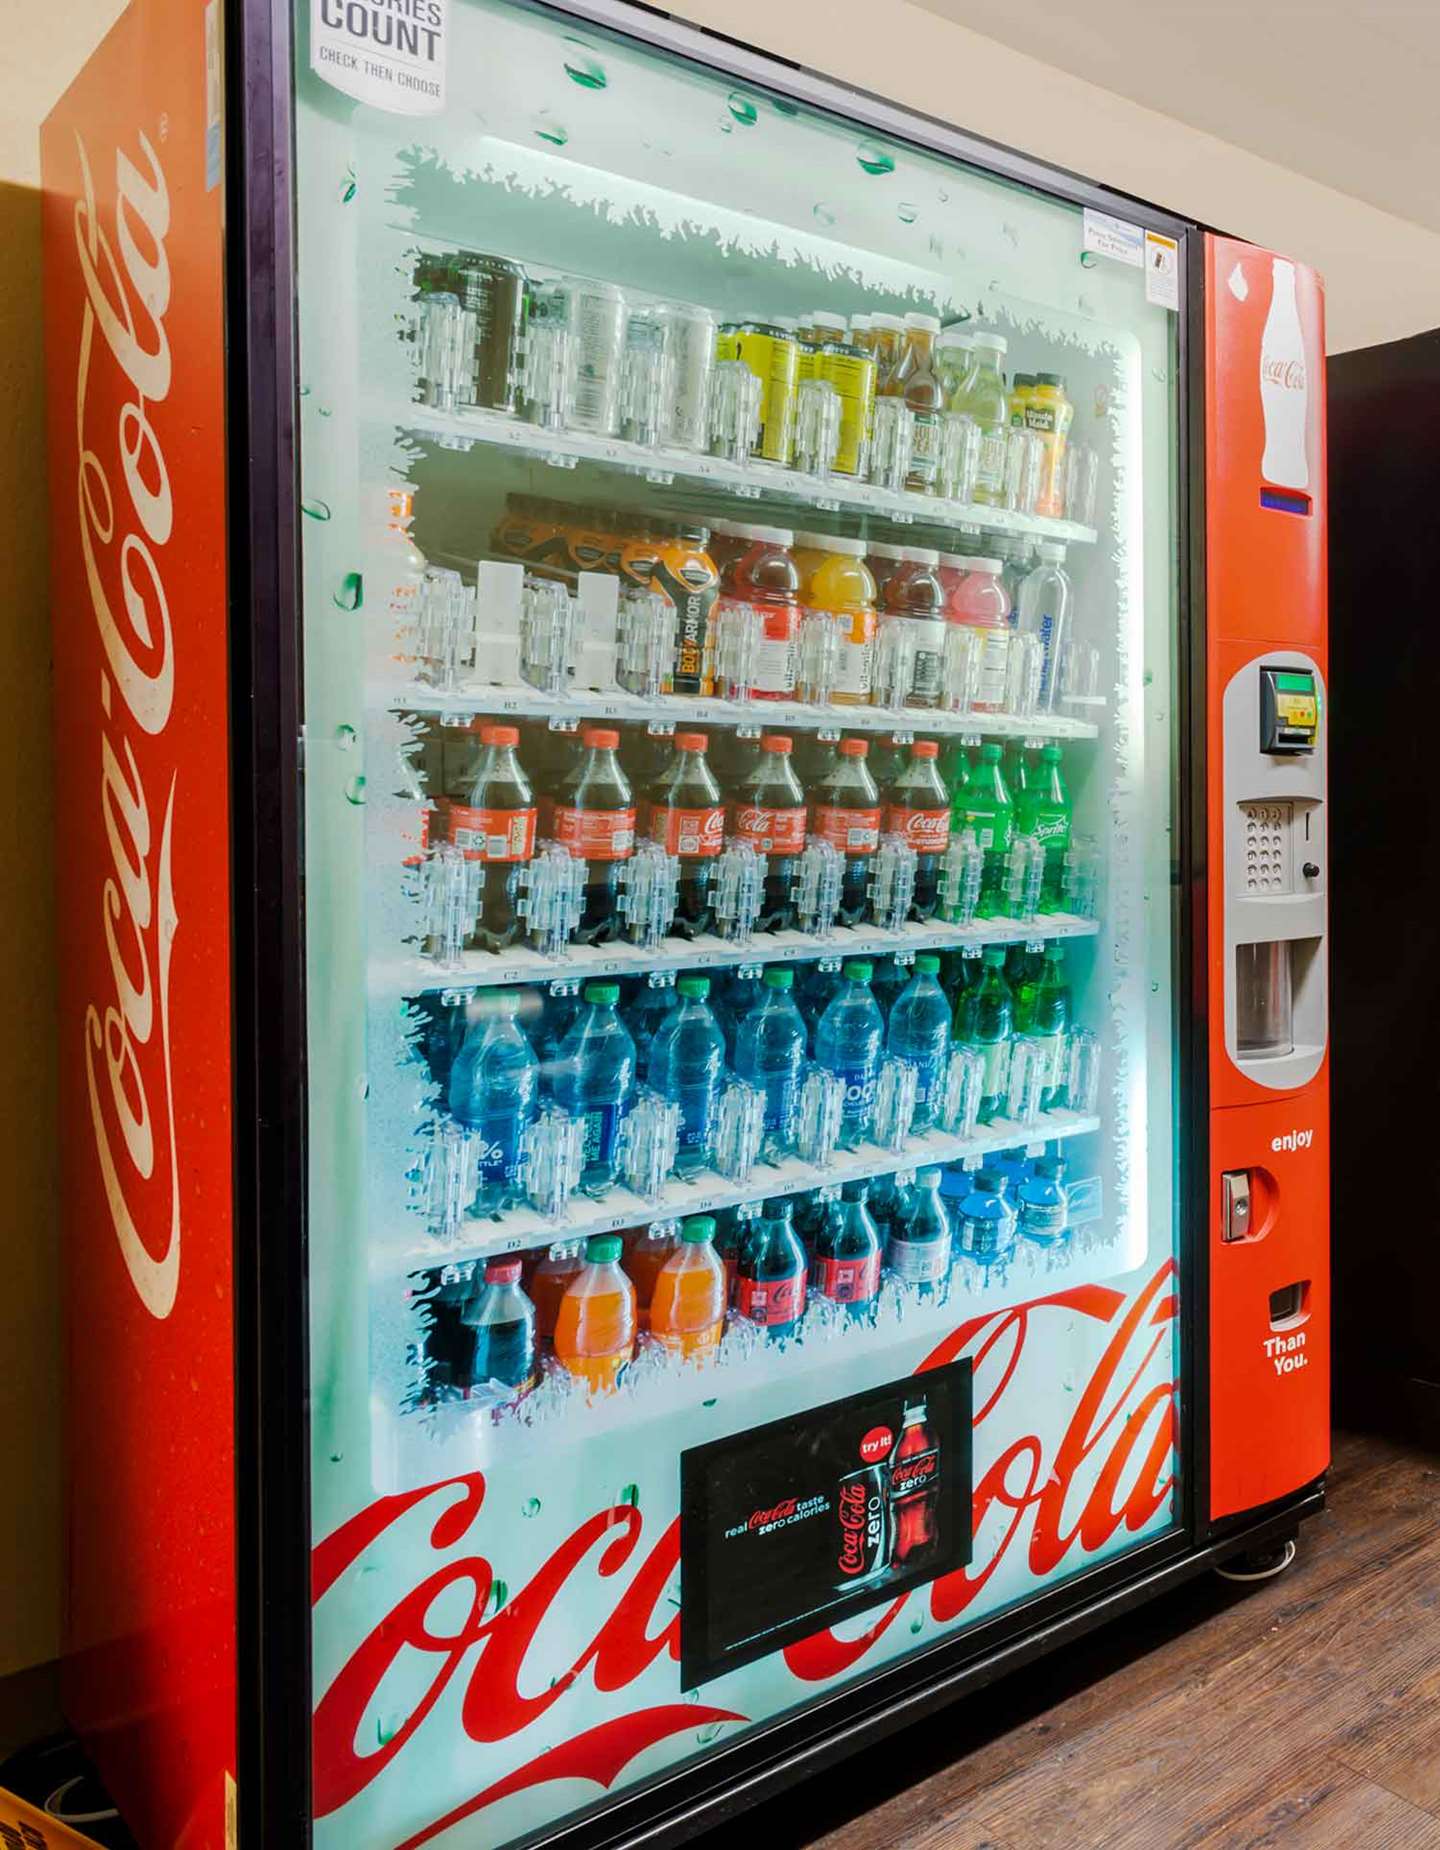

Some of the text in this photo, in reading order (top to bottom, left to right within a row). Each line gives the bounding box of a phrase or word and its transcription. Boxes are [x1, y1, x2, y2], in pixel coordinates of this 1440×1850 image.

[321, 0, 441, 61] COUNT
[320, 46, 441, 98] CHECK THEN CHOOSE
[1271, 1129, 1314, 1151] enjoy
[1263, 1332, 1306, 1358] Than
[1274, 1353, 1308, 1376] You.
[862, 1434, 892, 1455] try it!
[899, 1474, 927, 1491] zero
[724, 1524, 748, 1539] real
[796, 1495, 824, 1511] taste
[758, 1502, 830, 1536] zero calories
[867, 1496, 881, 1548] zero
